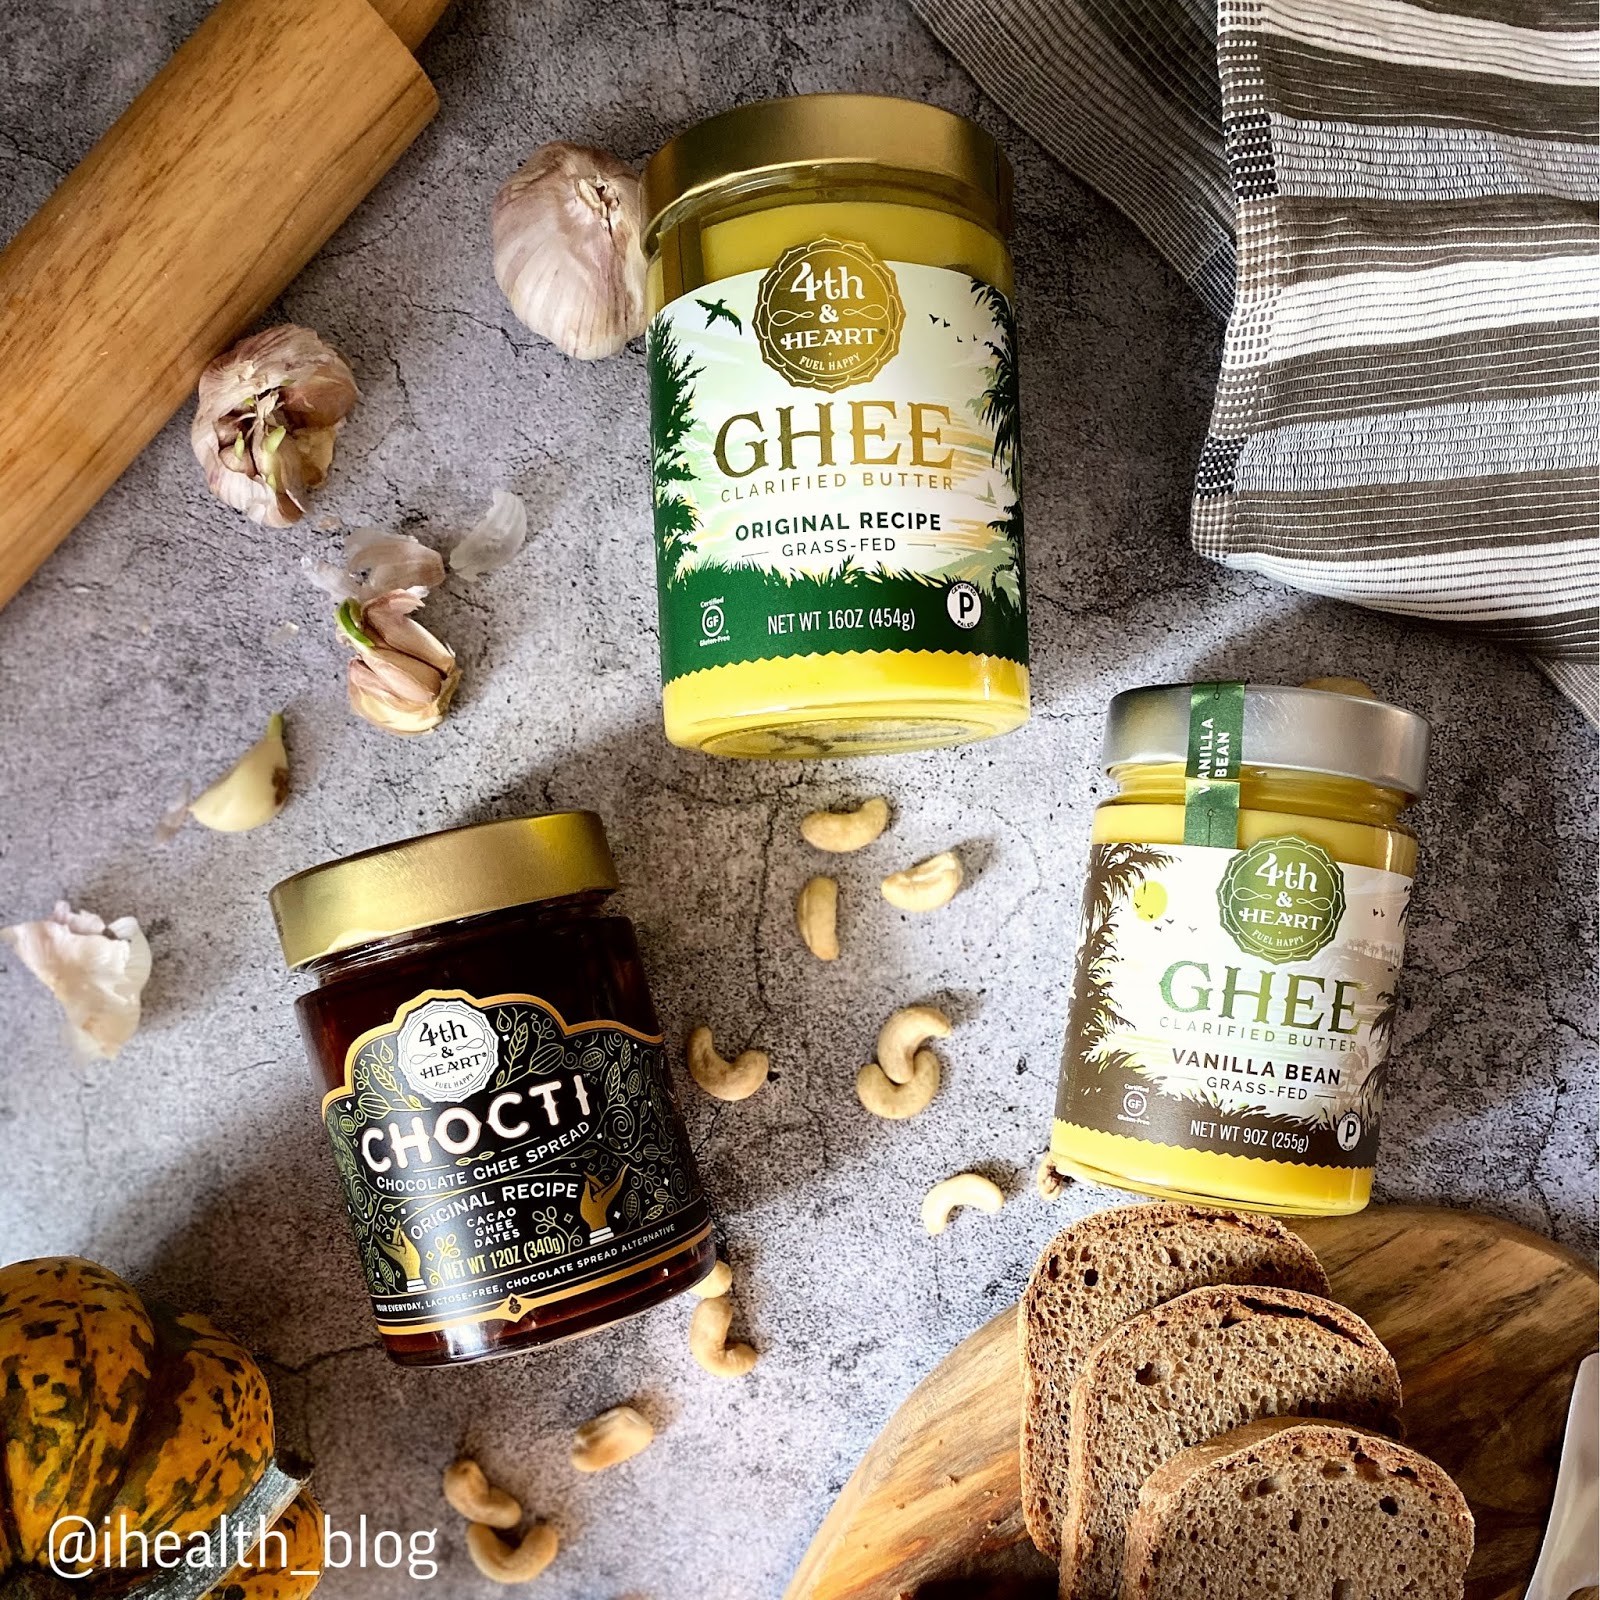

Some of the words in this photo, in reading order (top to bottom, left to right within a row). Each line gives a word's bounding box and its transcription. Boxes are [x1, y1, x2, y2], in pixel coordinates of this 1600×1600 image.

[790, 262, 865, 301] 4th
[819, 304, 839, 323] &
[780, 328, 879, 350] HEART
[799, 355, 825, 370] FUEL
[828, 352, 861, 371] HAPPY
[712, 400, 957, 478] GHEE
[720, 473, 847, 503] CLARIFIED
[862, 472, 955, 491] BUTTER
[735, 513, 850, 542] ORIGINAL
[859, 512, 941, 531] RECIPE
[781, 537, 896, 558] GRASS-FED
[959, 592, 974, 619] P
[706, 615, 719, 628] GF
[767, 614, 795, 636] NET
[798, 611, 821, 633] WT
[869, 608, 916, 632] (454g)
[1197, 717, 1214, 795] VANILLA
[1215, 732, 1230, 778] BEAN
[1255, 852, 1317, 892] 4th
[1276, 891, 1293, 908] &
[1238, 907, 1322, 931] HEART
[1251, 929, 1273, 946] FUEL
[1276, 935, 1304, 947] HAPPY
[1159, 960, 1365, 1036] GHEE
[419, 1020, 468, 1047] 4th
[1159, 1016, 1275, 1042] CLARIFIED
[1288, 1033, 1357, 1052] BUTTER
[441, 1046, 454, 1058] &
[1172, 1048, 1275, 1078] VANILLA
[1285, 1063, 1341, 1085] BEAN
[435, 1081, 452, 1089] FUEL
[453, 1073, 474, 1088] HAPPY
[1206, 1077, 1308, 1100] GRASS-FED
[1127, 1099, 1142, 1109] GF
[361, 1074, 592, 1173] CHOCTI
[1190, 1120, 1217, 1138] NET
[1219, 1125, 1240, 1142] WT
[1271, 1131, 1310, 1153] (255g)
[1345, 1121, 1357, 1142] P
[376, 1171, 468, 1193] CHOCOLATE
[473, 1155, 521, 1181] GHEE
[526, 1120, 591, 1163] SPREAD
[410, 1191, 496, 1240] ORIGINAL
[501, 1182, 579, 1202] RECIPE
[466, 1207, 517, 1228] CACAO
[474, 1228, 521, 1248] DATES
[475, 1218, 514, 1237] GHEE
[388, 1301, 424, 1313] EVERYDAY,
[426, 1284, 504, 1308] LACTOSE-FREE,
[506, 1263, 574, 1289] CHOCOLATE
[577, 1248, 618, 1268] SPREAD
[621, 1223, 676, 1252] ALTERNATIVE
[443, 1259, 466, 1281] NET
[467, 1254, 487, 1276] WT
[523, 1232, 566, 1264] (340g)
